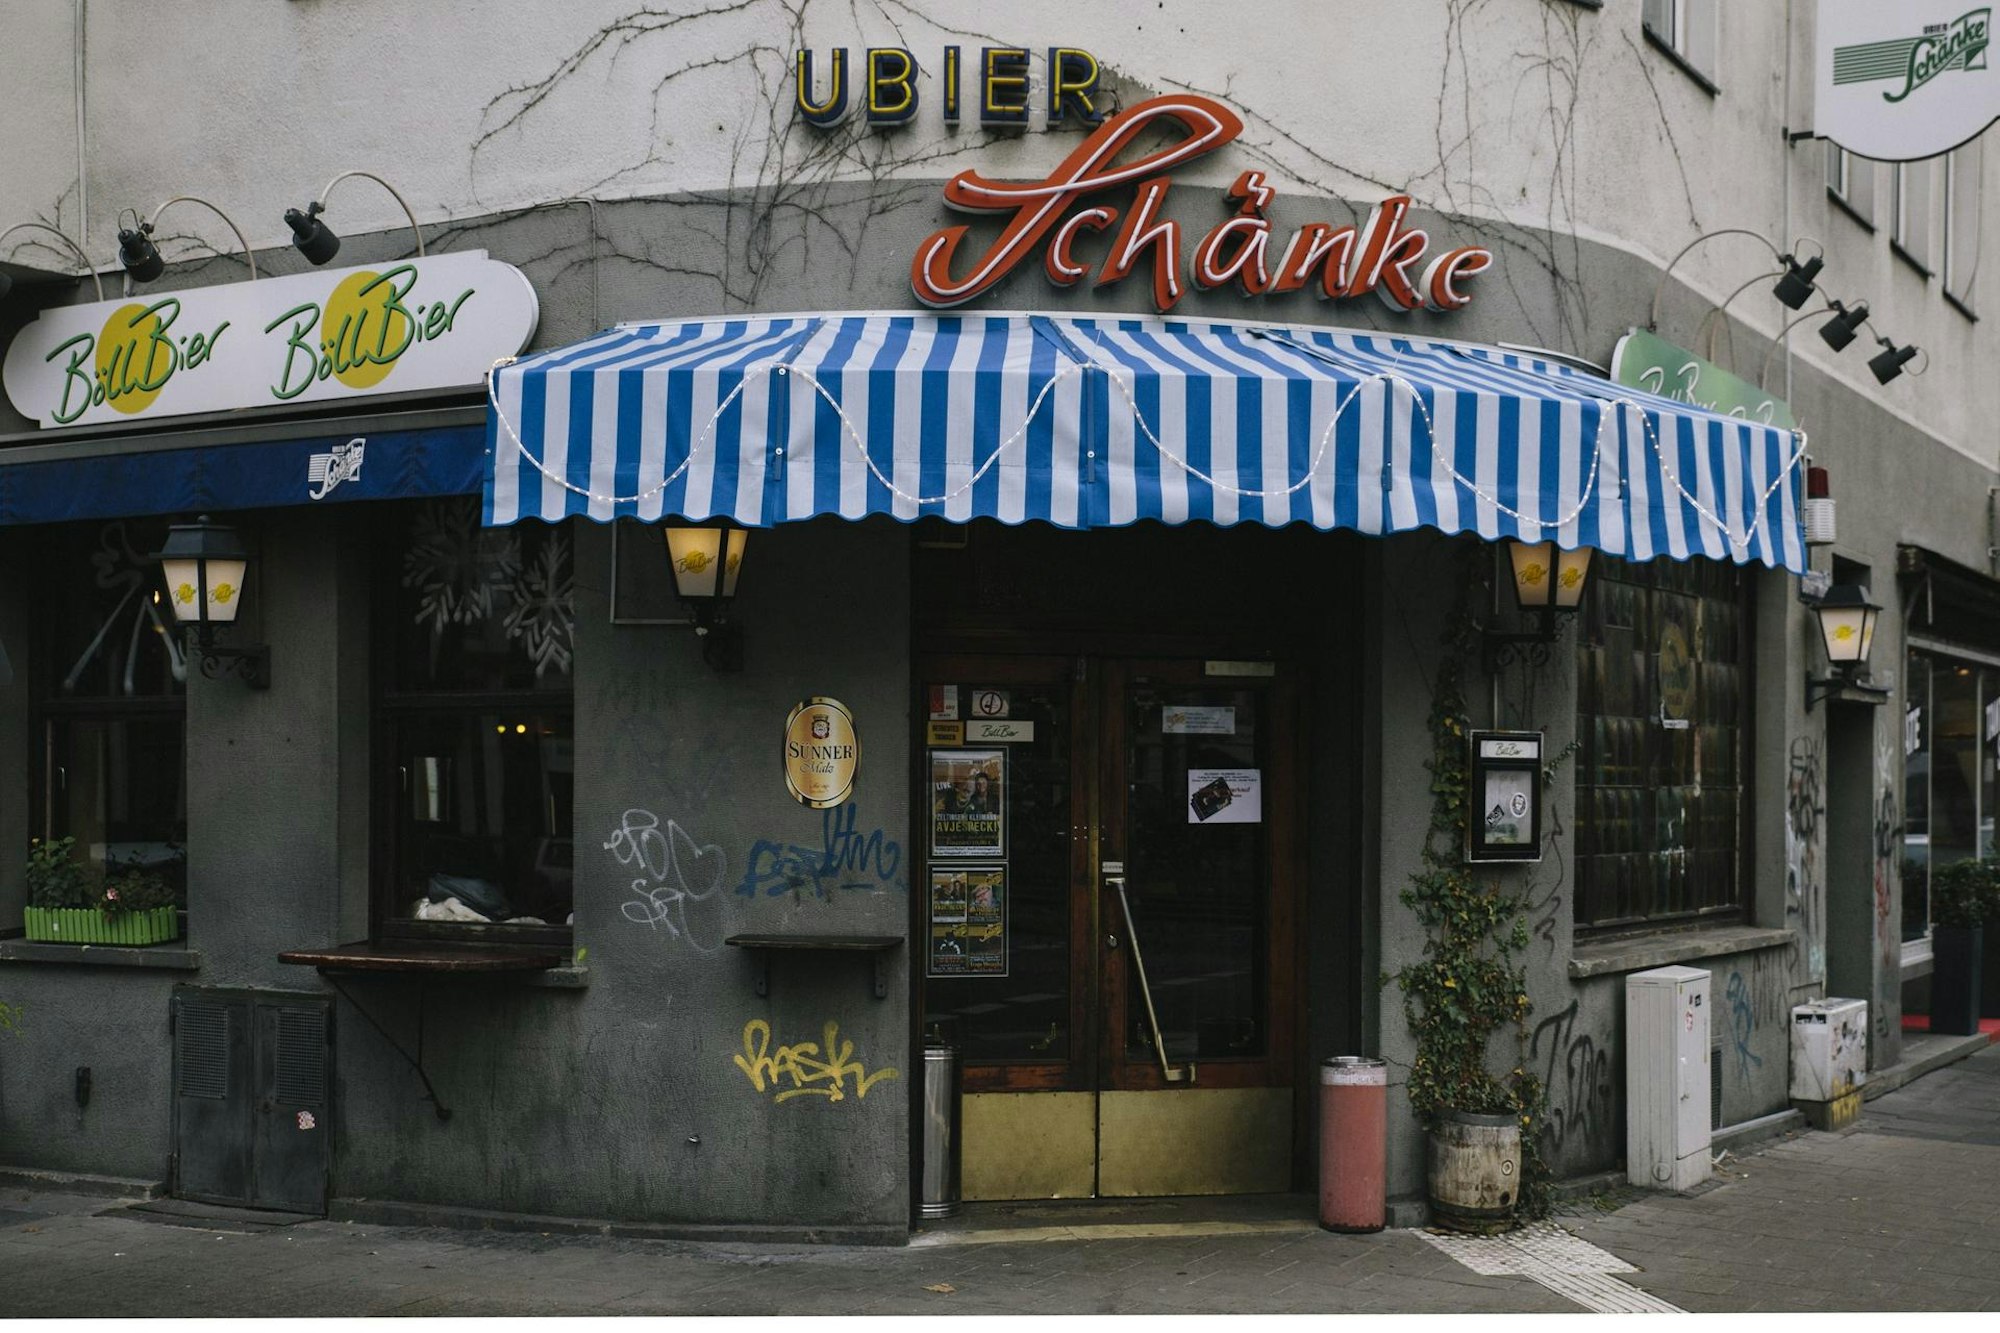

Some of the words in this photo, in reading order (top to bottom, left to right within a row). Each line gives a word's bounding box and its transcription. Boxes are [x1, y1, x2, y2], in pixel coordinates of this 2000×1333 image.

[797, 46, 1101, 127] UBIER
[911, 94, 1493, 311] Schänke
[789, 741, 853, 760] SÜNNER
[800, 761, 835, 775] Malz
